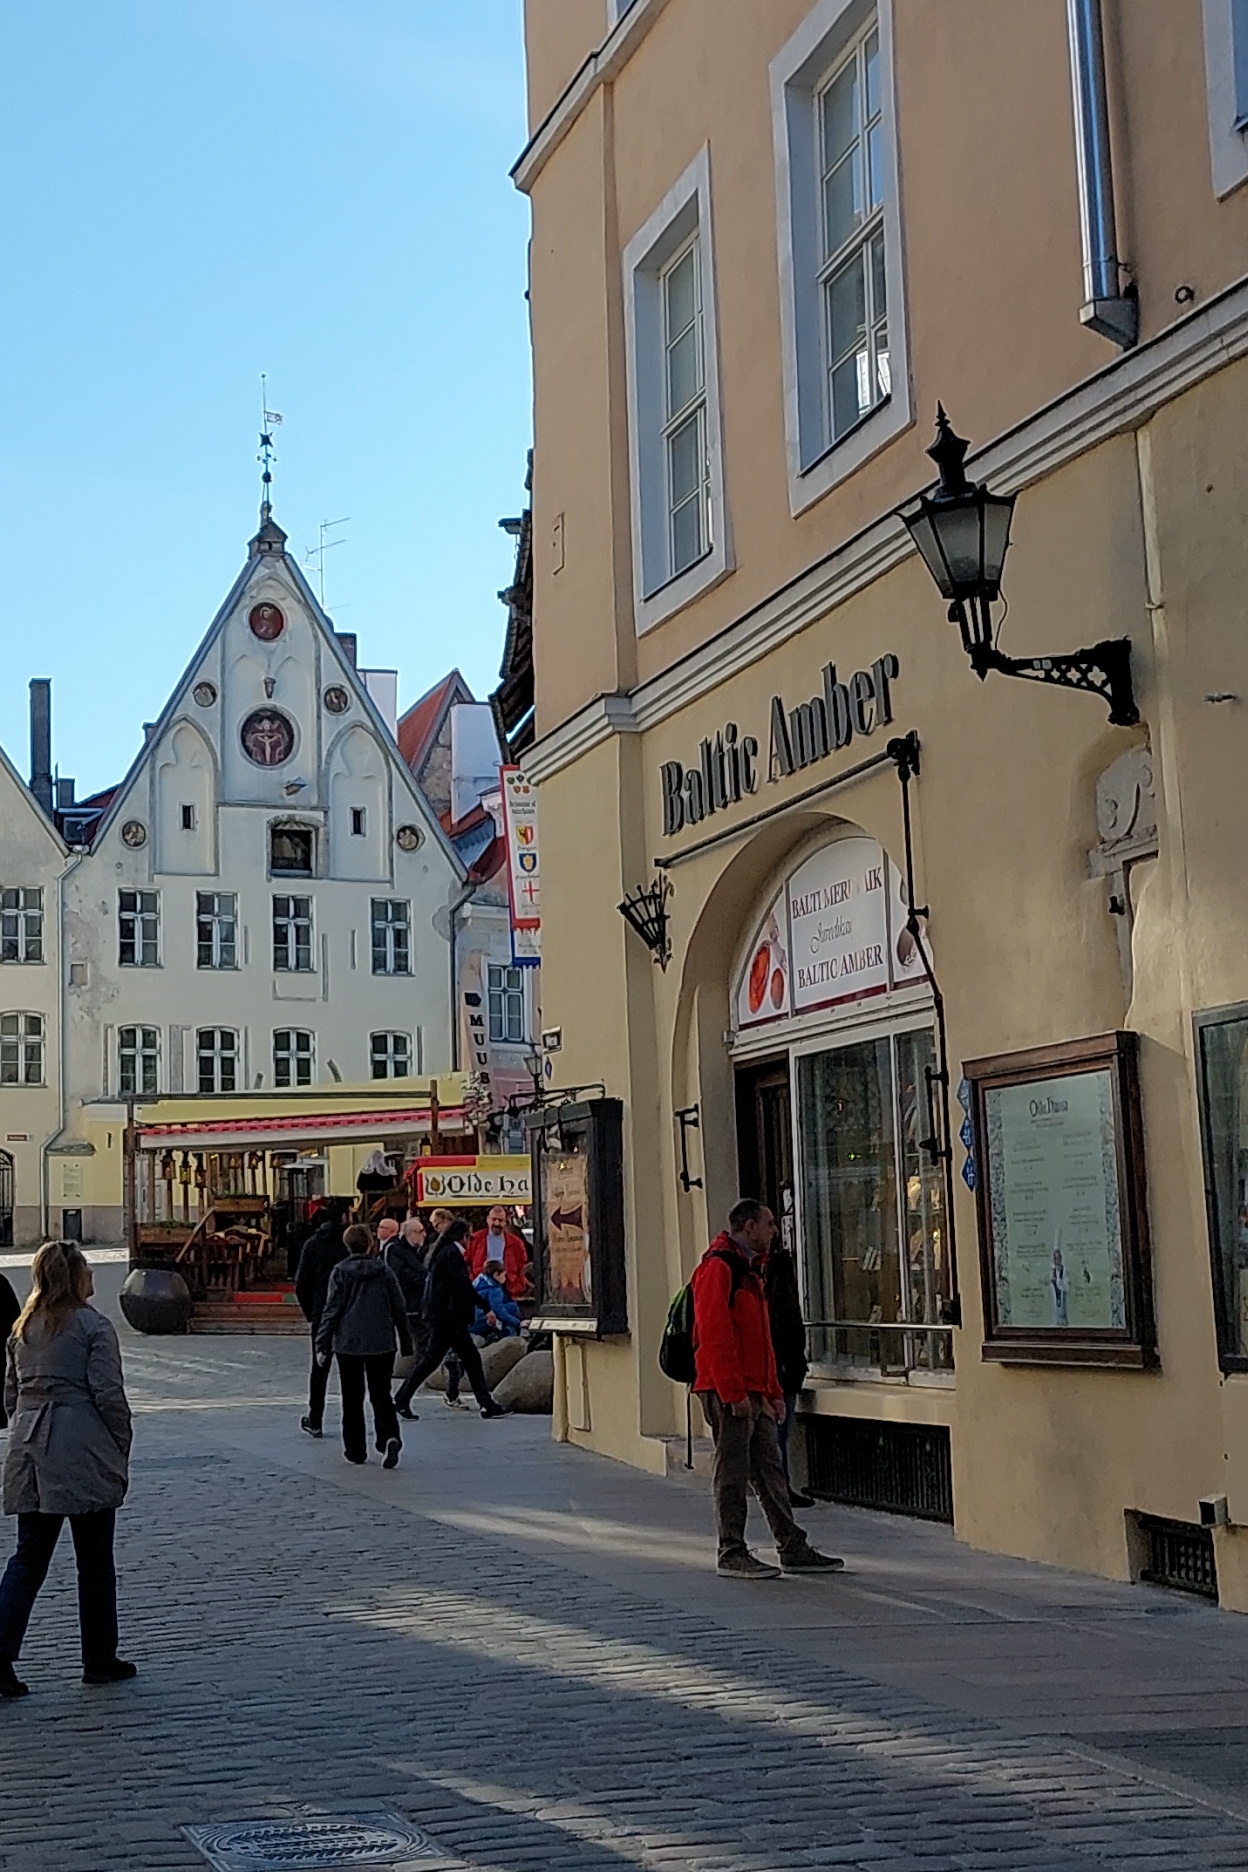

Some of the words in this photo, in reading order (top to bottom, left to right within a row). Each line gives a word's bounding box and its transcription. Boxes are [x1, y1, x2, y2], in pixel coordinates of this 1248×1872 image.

[659, 721, 758, 836] Baltic
[766, 653, 900, 784] Amber
[797, 957, 838, 989] BALTIC
[839, 944, 884, 977] AMBER
[446, 1172, 494, 1194] Olde
